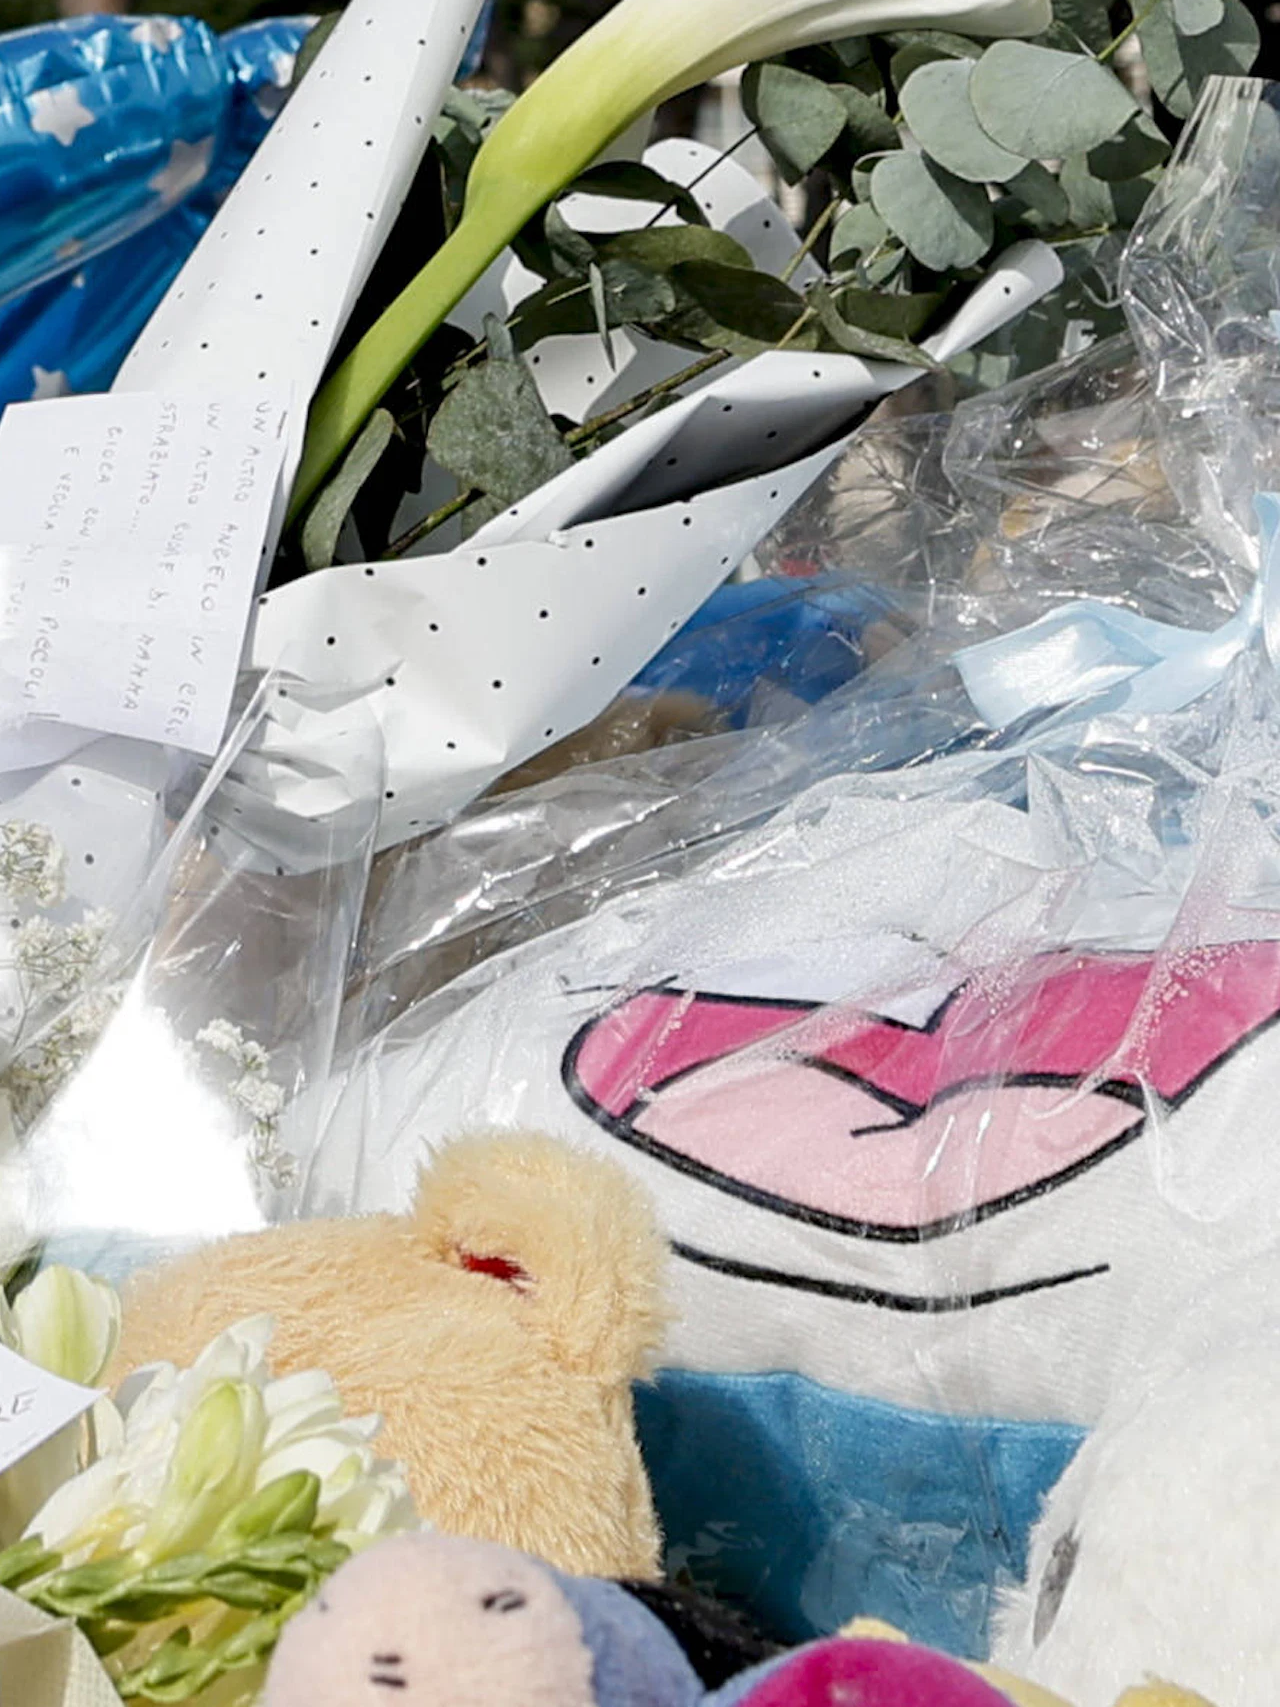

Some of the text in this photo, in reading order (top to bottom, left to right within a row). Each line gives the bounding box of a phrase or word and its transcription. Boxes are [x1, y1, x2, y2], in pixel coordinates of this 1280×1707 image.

[205, 402, 222, 432] UN
[251, 399, 272, 434] UN
[187, 445, 213, 506] ALTRO
[233, 444, 261, 503] ALTRO
